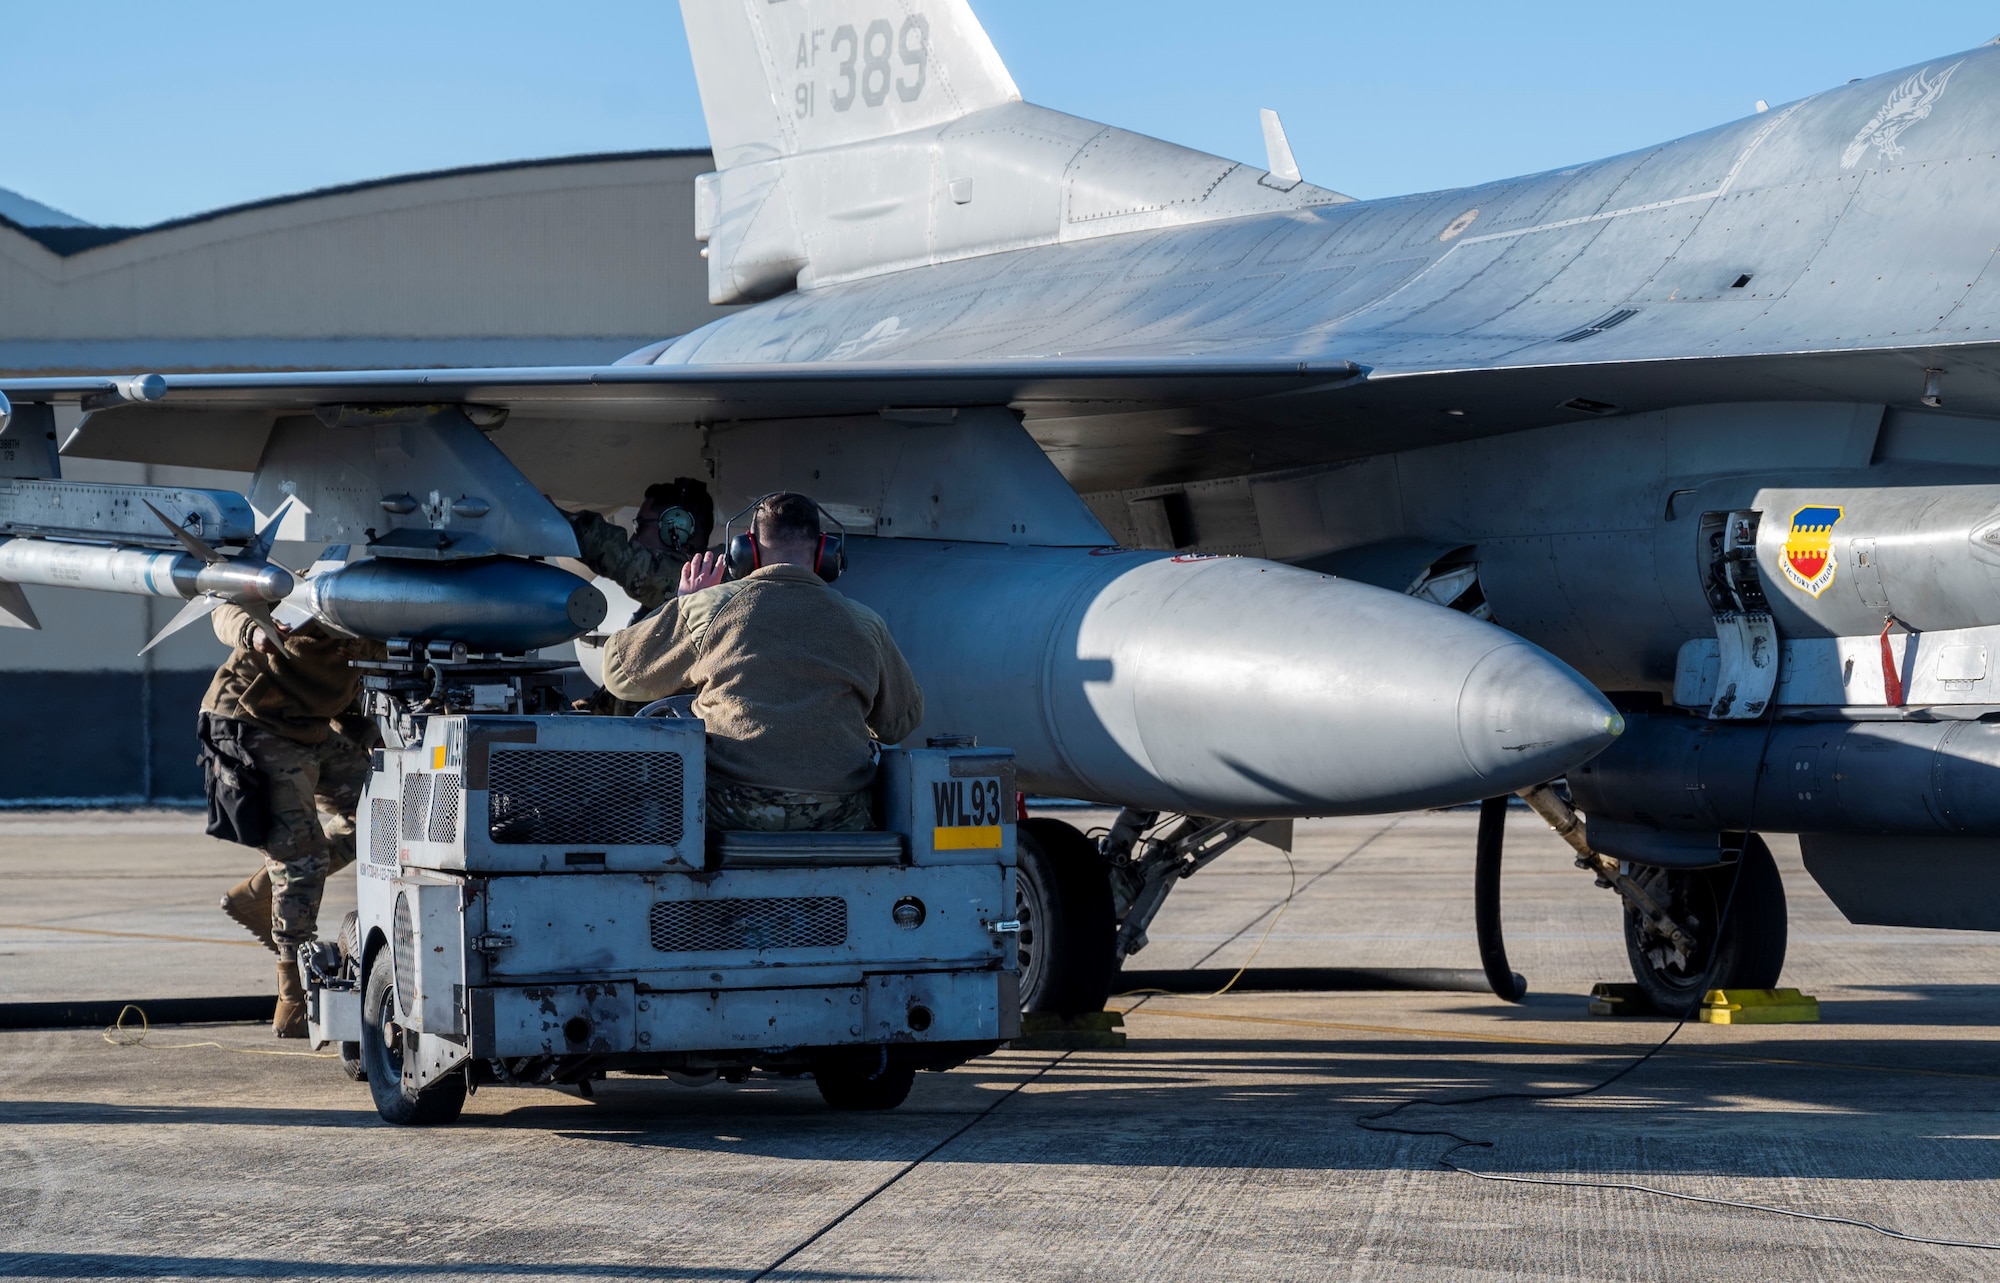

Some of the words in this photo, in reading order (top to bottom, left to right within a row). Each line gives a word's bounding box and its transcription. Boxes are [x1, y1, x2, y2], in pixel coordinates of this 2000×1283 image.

[796, 29, 825, 69] AF
[830, 13, 930, 112] 389
[796, 80, 814, 120] 91
[1783, 561, 1810, 589] VICTORY
[1812, 581, 1820, 592] BY
[1819, 562, 1833, 584] VALOR
[933, 780, 1000, 827] WL93
